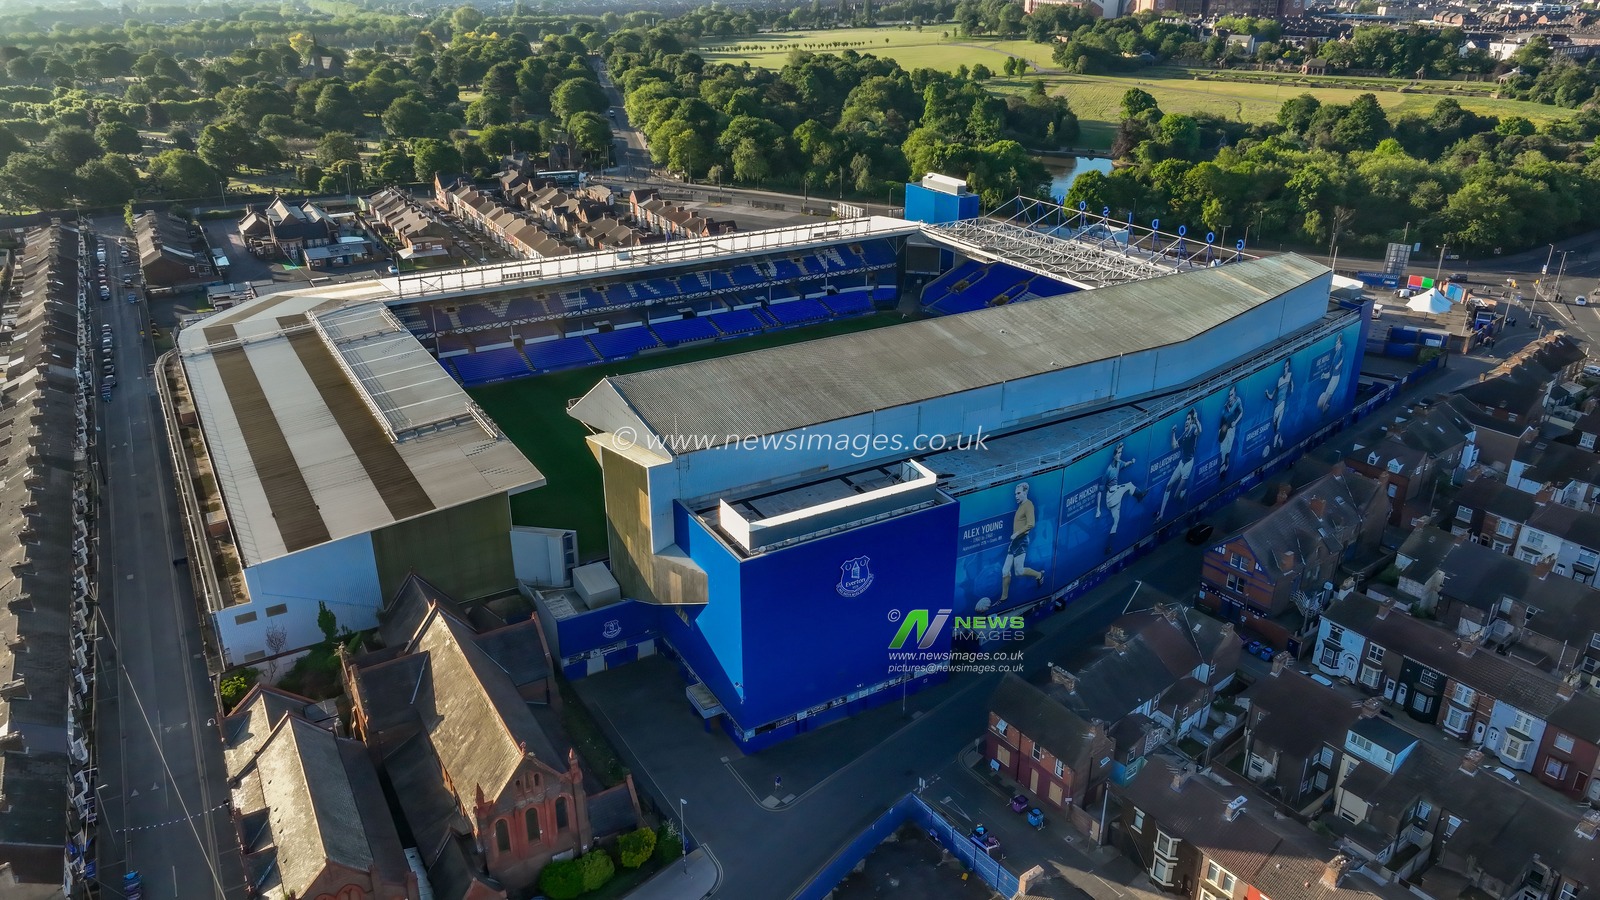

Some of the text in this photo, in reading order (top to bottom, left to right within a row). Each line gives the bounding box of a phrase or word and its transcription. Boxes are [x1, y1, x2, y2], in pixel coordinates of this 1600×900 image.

[963, 526, 981, 540] ALEX
[981, 520, 1003, 536] YOUNG
[845, 577, 866, 588] Everton
